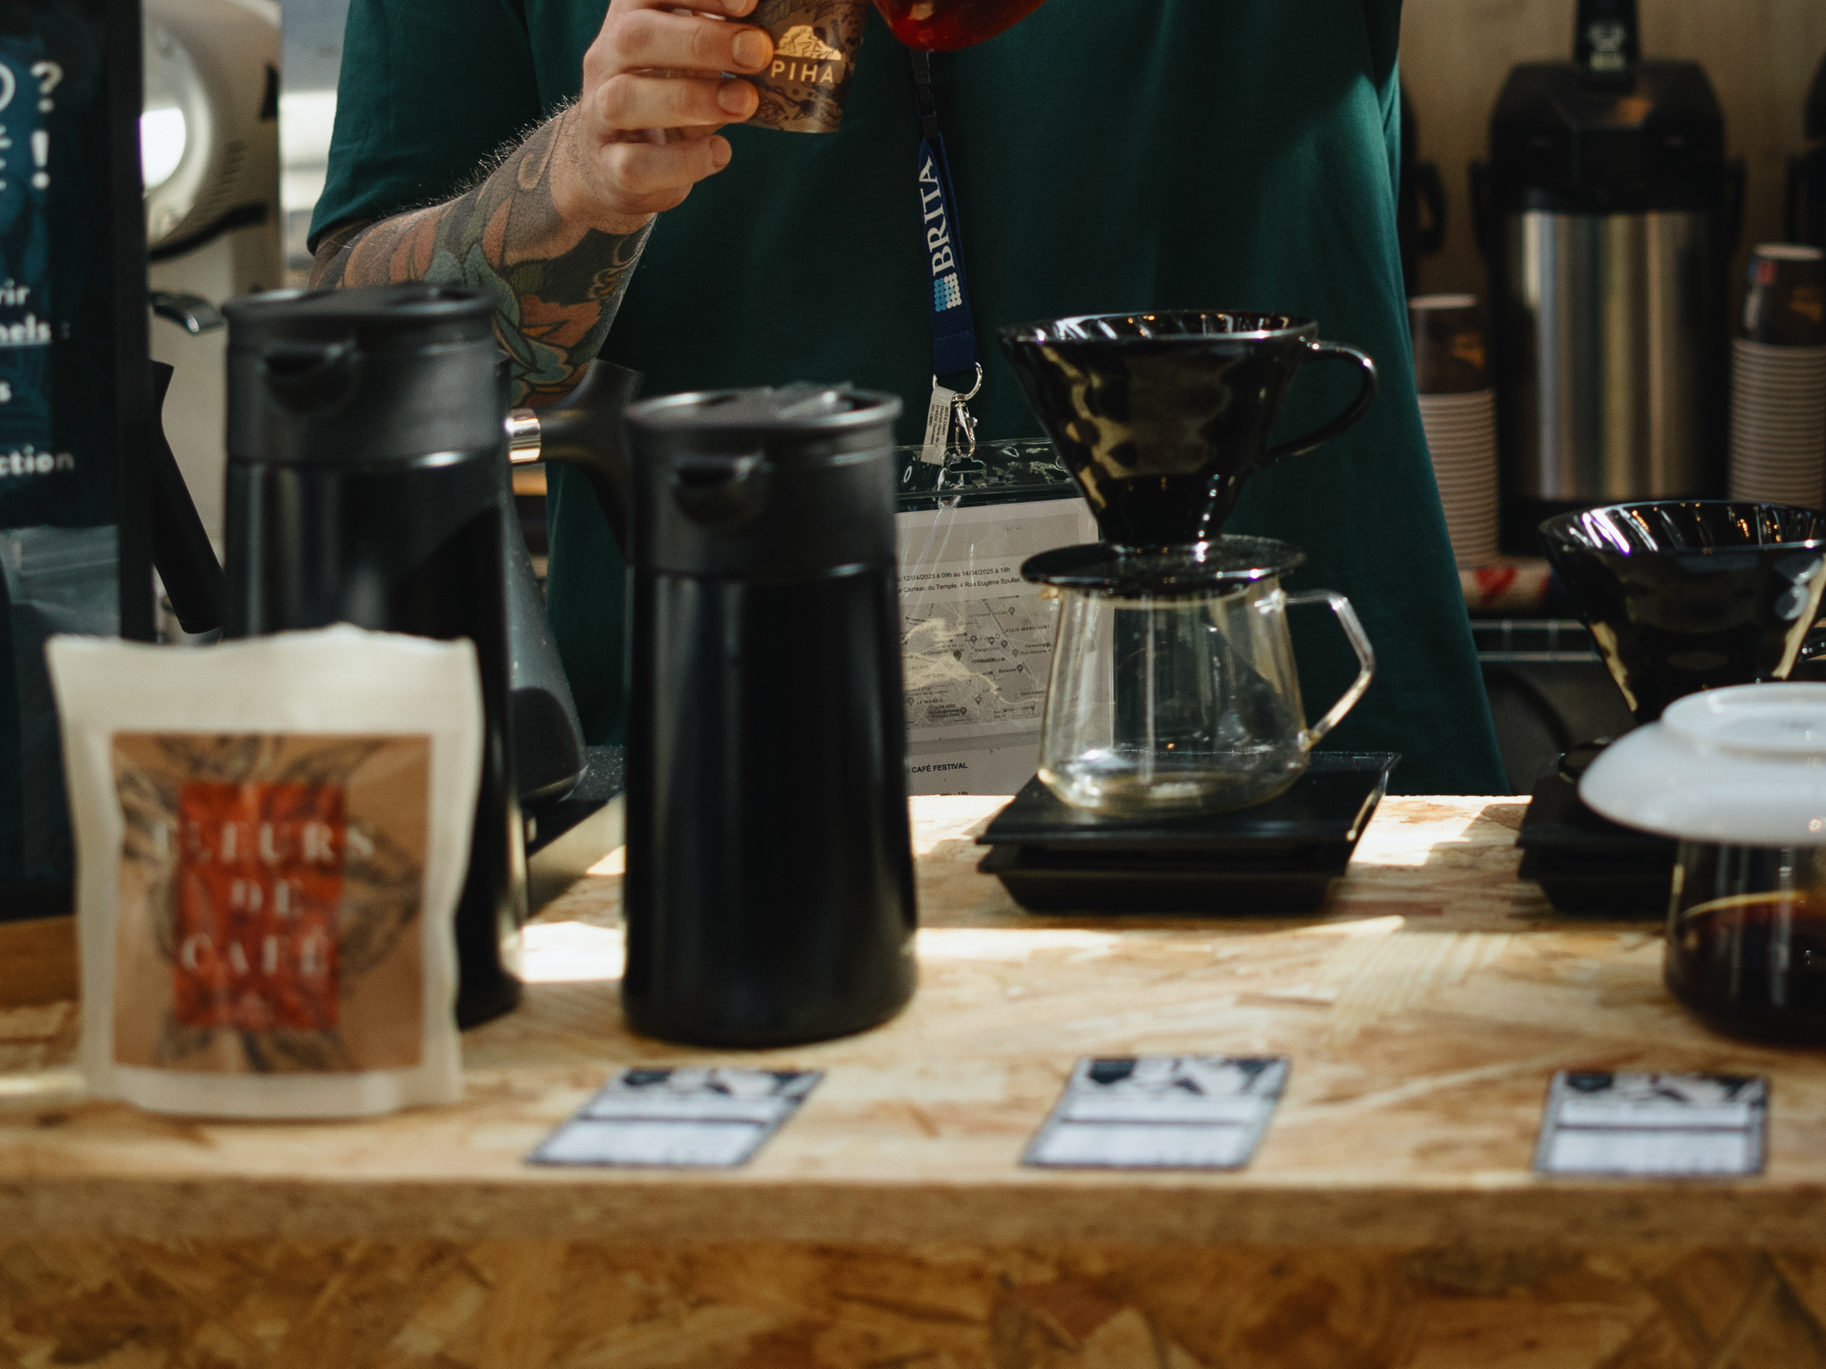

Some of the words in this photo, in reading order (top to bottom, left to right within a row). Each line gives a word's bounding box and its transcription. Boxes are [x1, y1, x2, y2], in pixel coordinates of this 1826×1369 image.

[770, 59, 834, 84] PIHA
[918, 155, 956, 277] BRITA
[911, 764, 932, 773] CAFÉ
[933, 762, 968, 772] FESTIVAL
